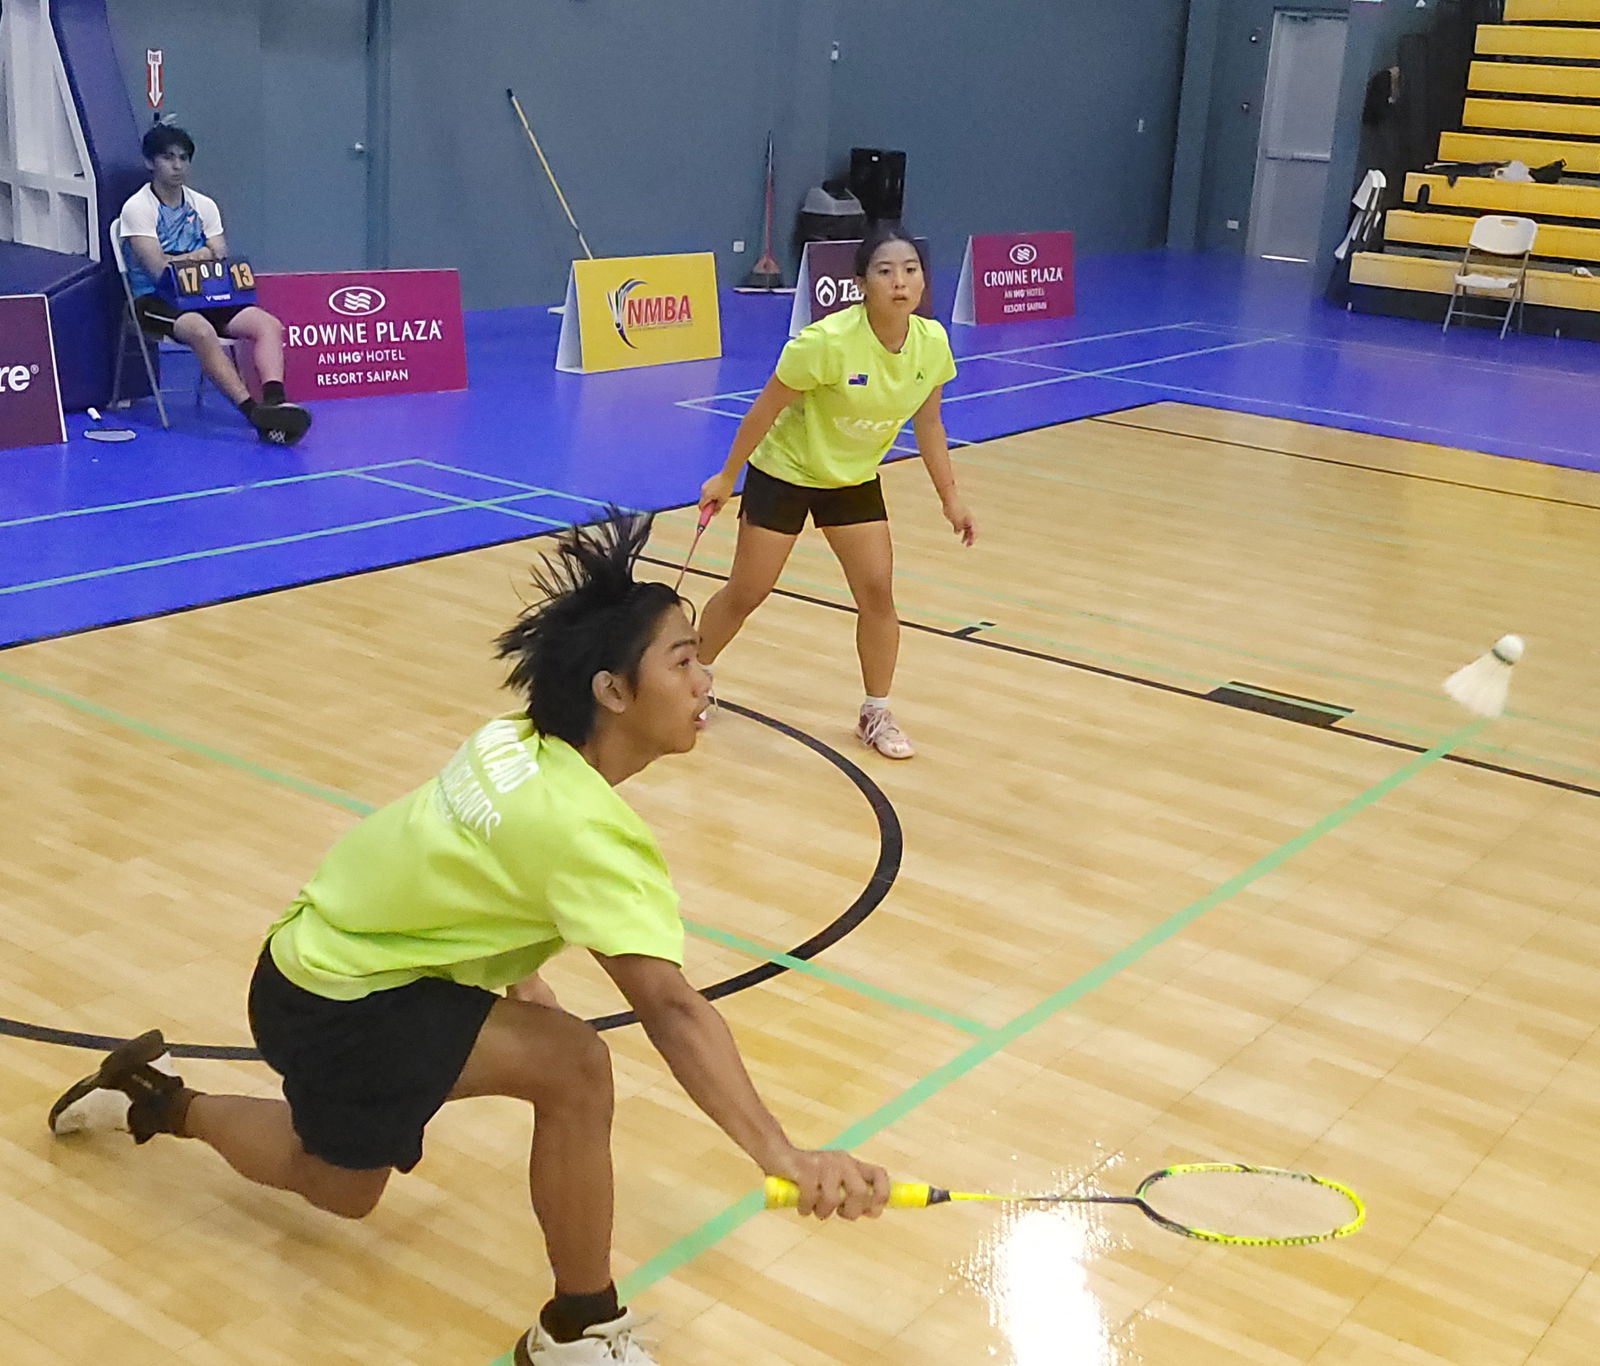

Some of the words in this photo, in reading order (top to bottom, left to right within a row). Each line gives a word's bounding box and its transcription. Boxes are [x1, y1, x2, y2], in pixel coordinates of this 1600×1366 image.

[178, 267, 198, 293] 17
[200, 263, 210, 278] 0
[215, 262, 223, 277] 0
[230, 262, 255, 288] 13
[984, 269, 1028, 288] CROWNE
[1031, 266, 1063, 284] PLAZA
[627, 294, 693, 328] NMBA
[376, 319, 443, 343] PLAZA
[318, 352, 336, 365] AN
[366, 349, 406, 362] HOTEL
[317, 371, 364, 386] RESORT
[366, 368, 409, 383] SAIPAN
